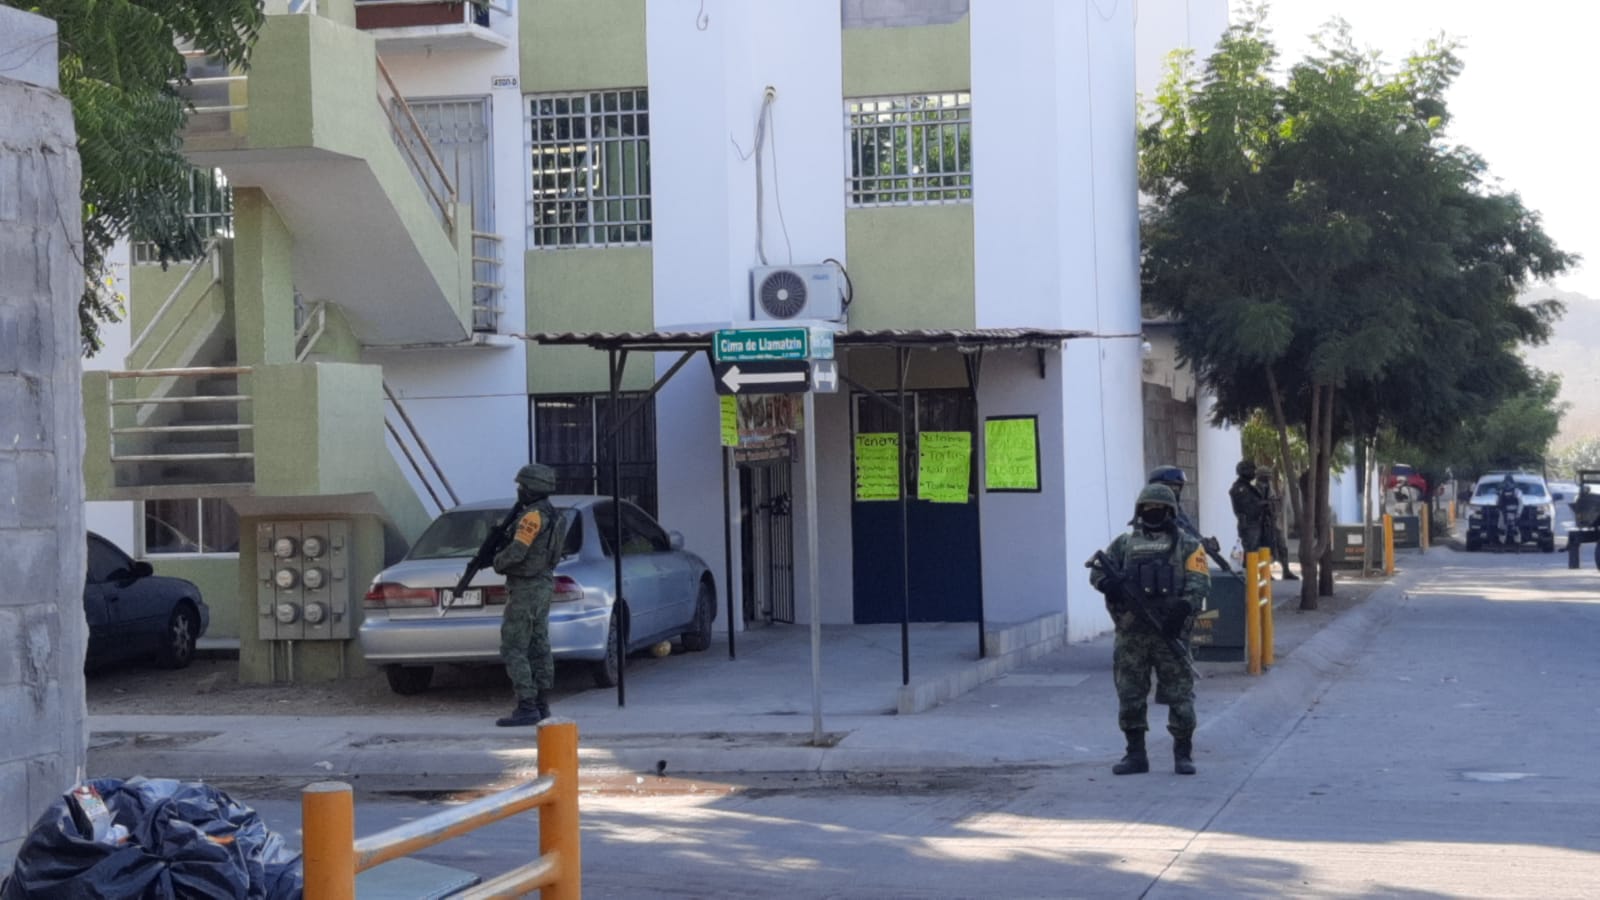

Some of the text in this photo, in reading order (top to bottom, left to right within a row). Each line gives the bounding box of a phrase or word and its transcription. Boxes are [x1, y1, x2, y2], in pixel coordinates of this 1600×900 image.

[721, 339, 744, 352] Cima
[746, 338, 757, 351] de
[759, 337, 802, 351] Llamatzin
